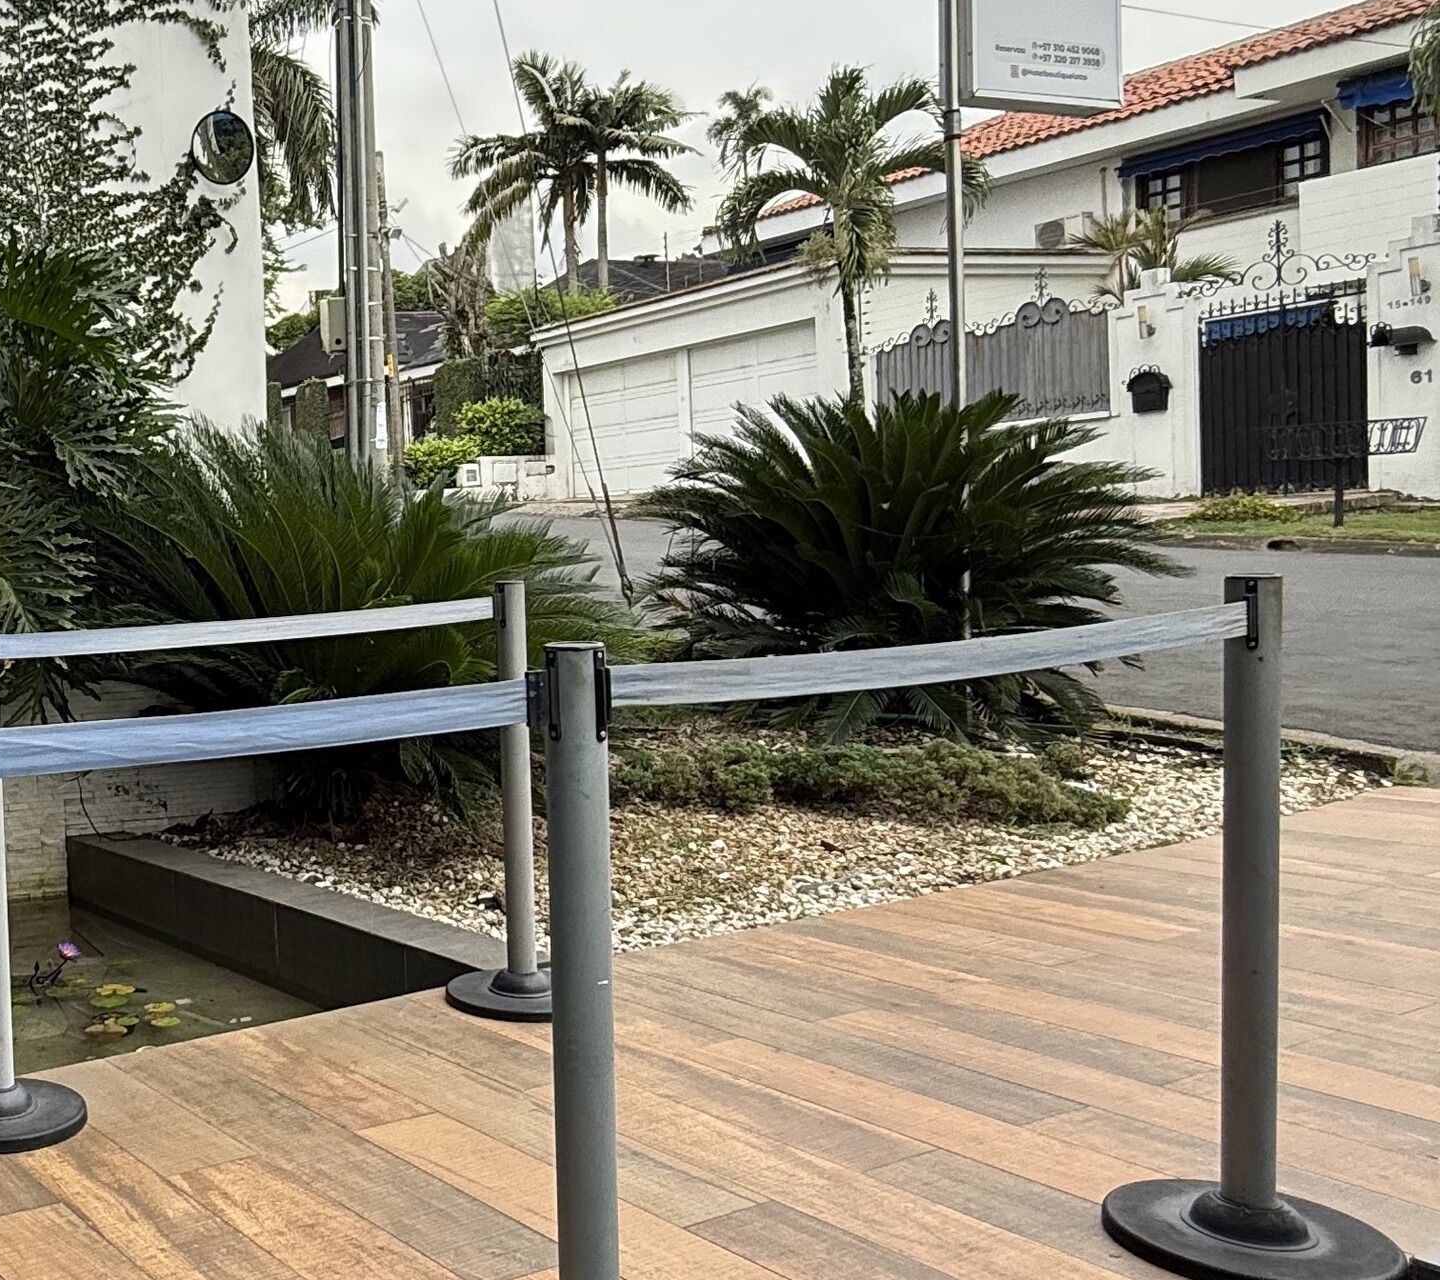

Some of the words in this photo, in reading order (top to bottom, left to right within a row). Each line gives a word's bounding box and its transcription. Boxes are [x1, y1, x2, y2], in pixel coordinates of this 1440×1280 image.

[1053, 43, 1065, 52] 310
[1066, 45, 1080, 54] 452
[1410, 368, 1433, 385] 61
